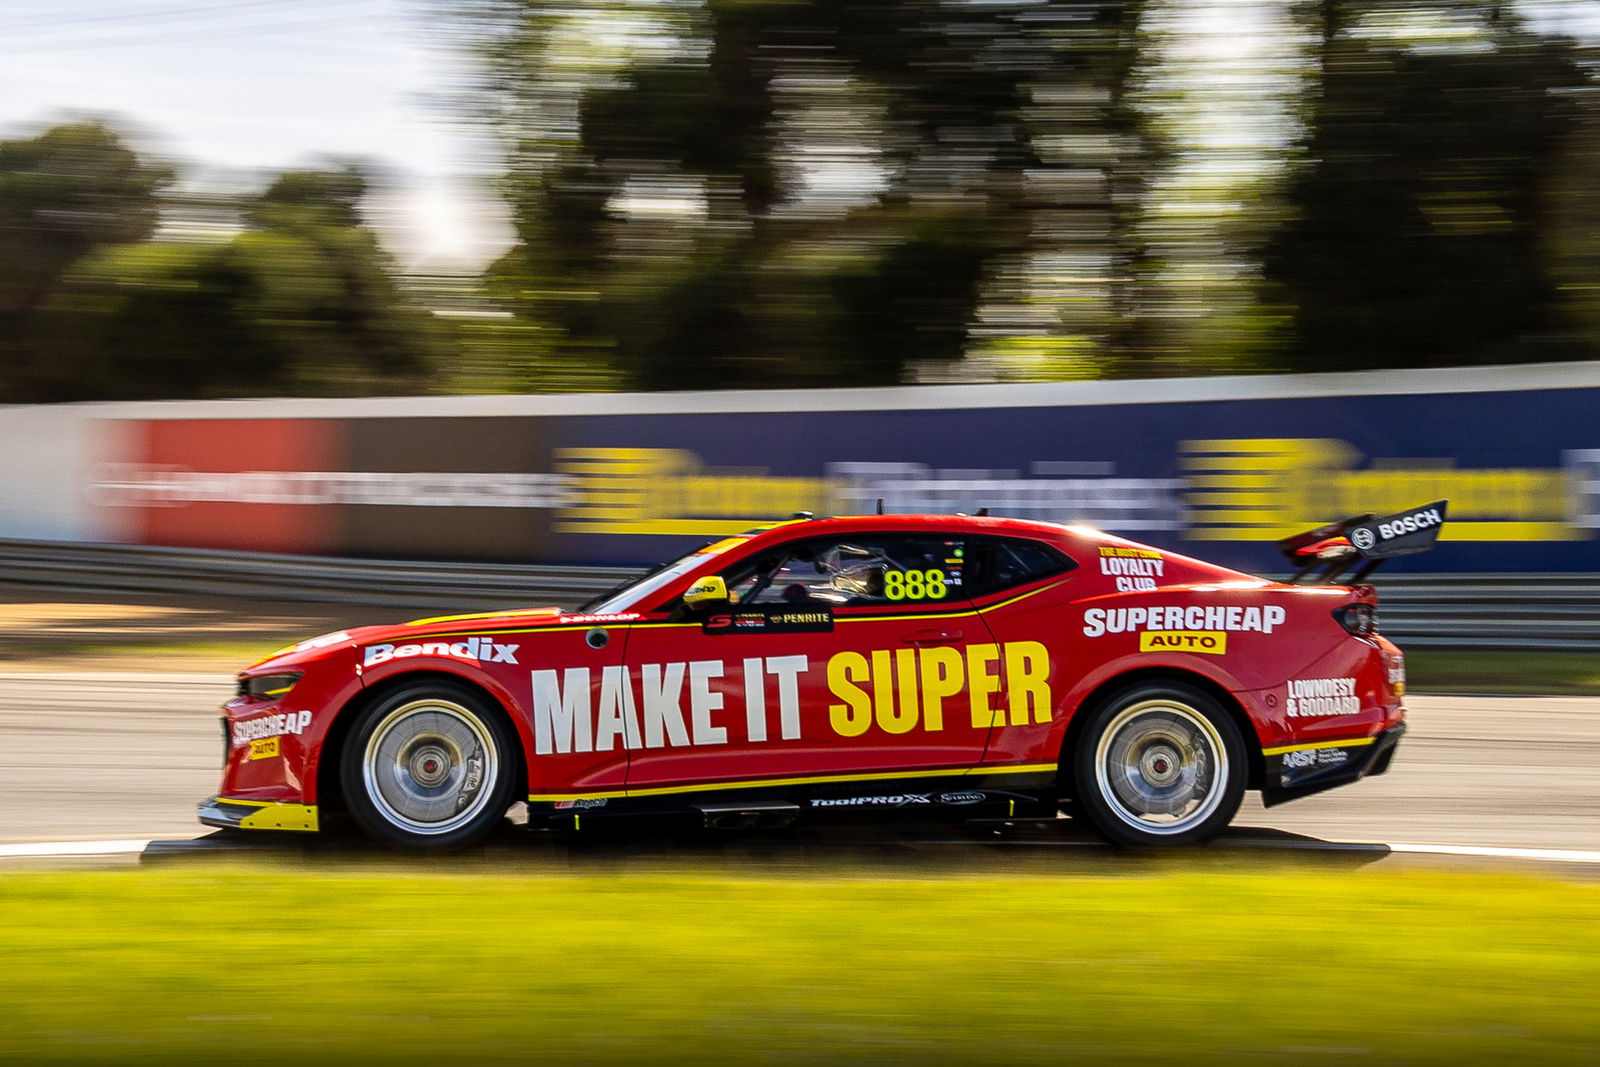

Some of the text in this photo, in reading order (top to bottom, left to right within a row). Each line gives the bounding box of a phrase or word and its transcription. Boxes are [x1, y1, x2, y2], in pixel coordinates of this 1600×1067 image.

[1378, 509, 1442, 540] BOSCH
[1100, 557, 1164, 577] LOYALTY
[885, 569, 947, 600] 888
[1116, 576, 1158, 592] CLUB
[783, 613, 829, 623] PENRITE
[1083, 605, 1286, 637] SUPERCHEAP
[363, 637, 520, 667] Bendix
[1149, 635, 1217, 648] AUTO
[531, 641, 1053, 755] MAKE IT SUPER
[1287, 678, 1357, 698] LOWNDESY
[1286, 696, 1360, 718] & GODDARD
[232, 710, 312, 745] SUPERCHEAP
